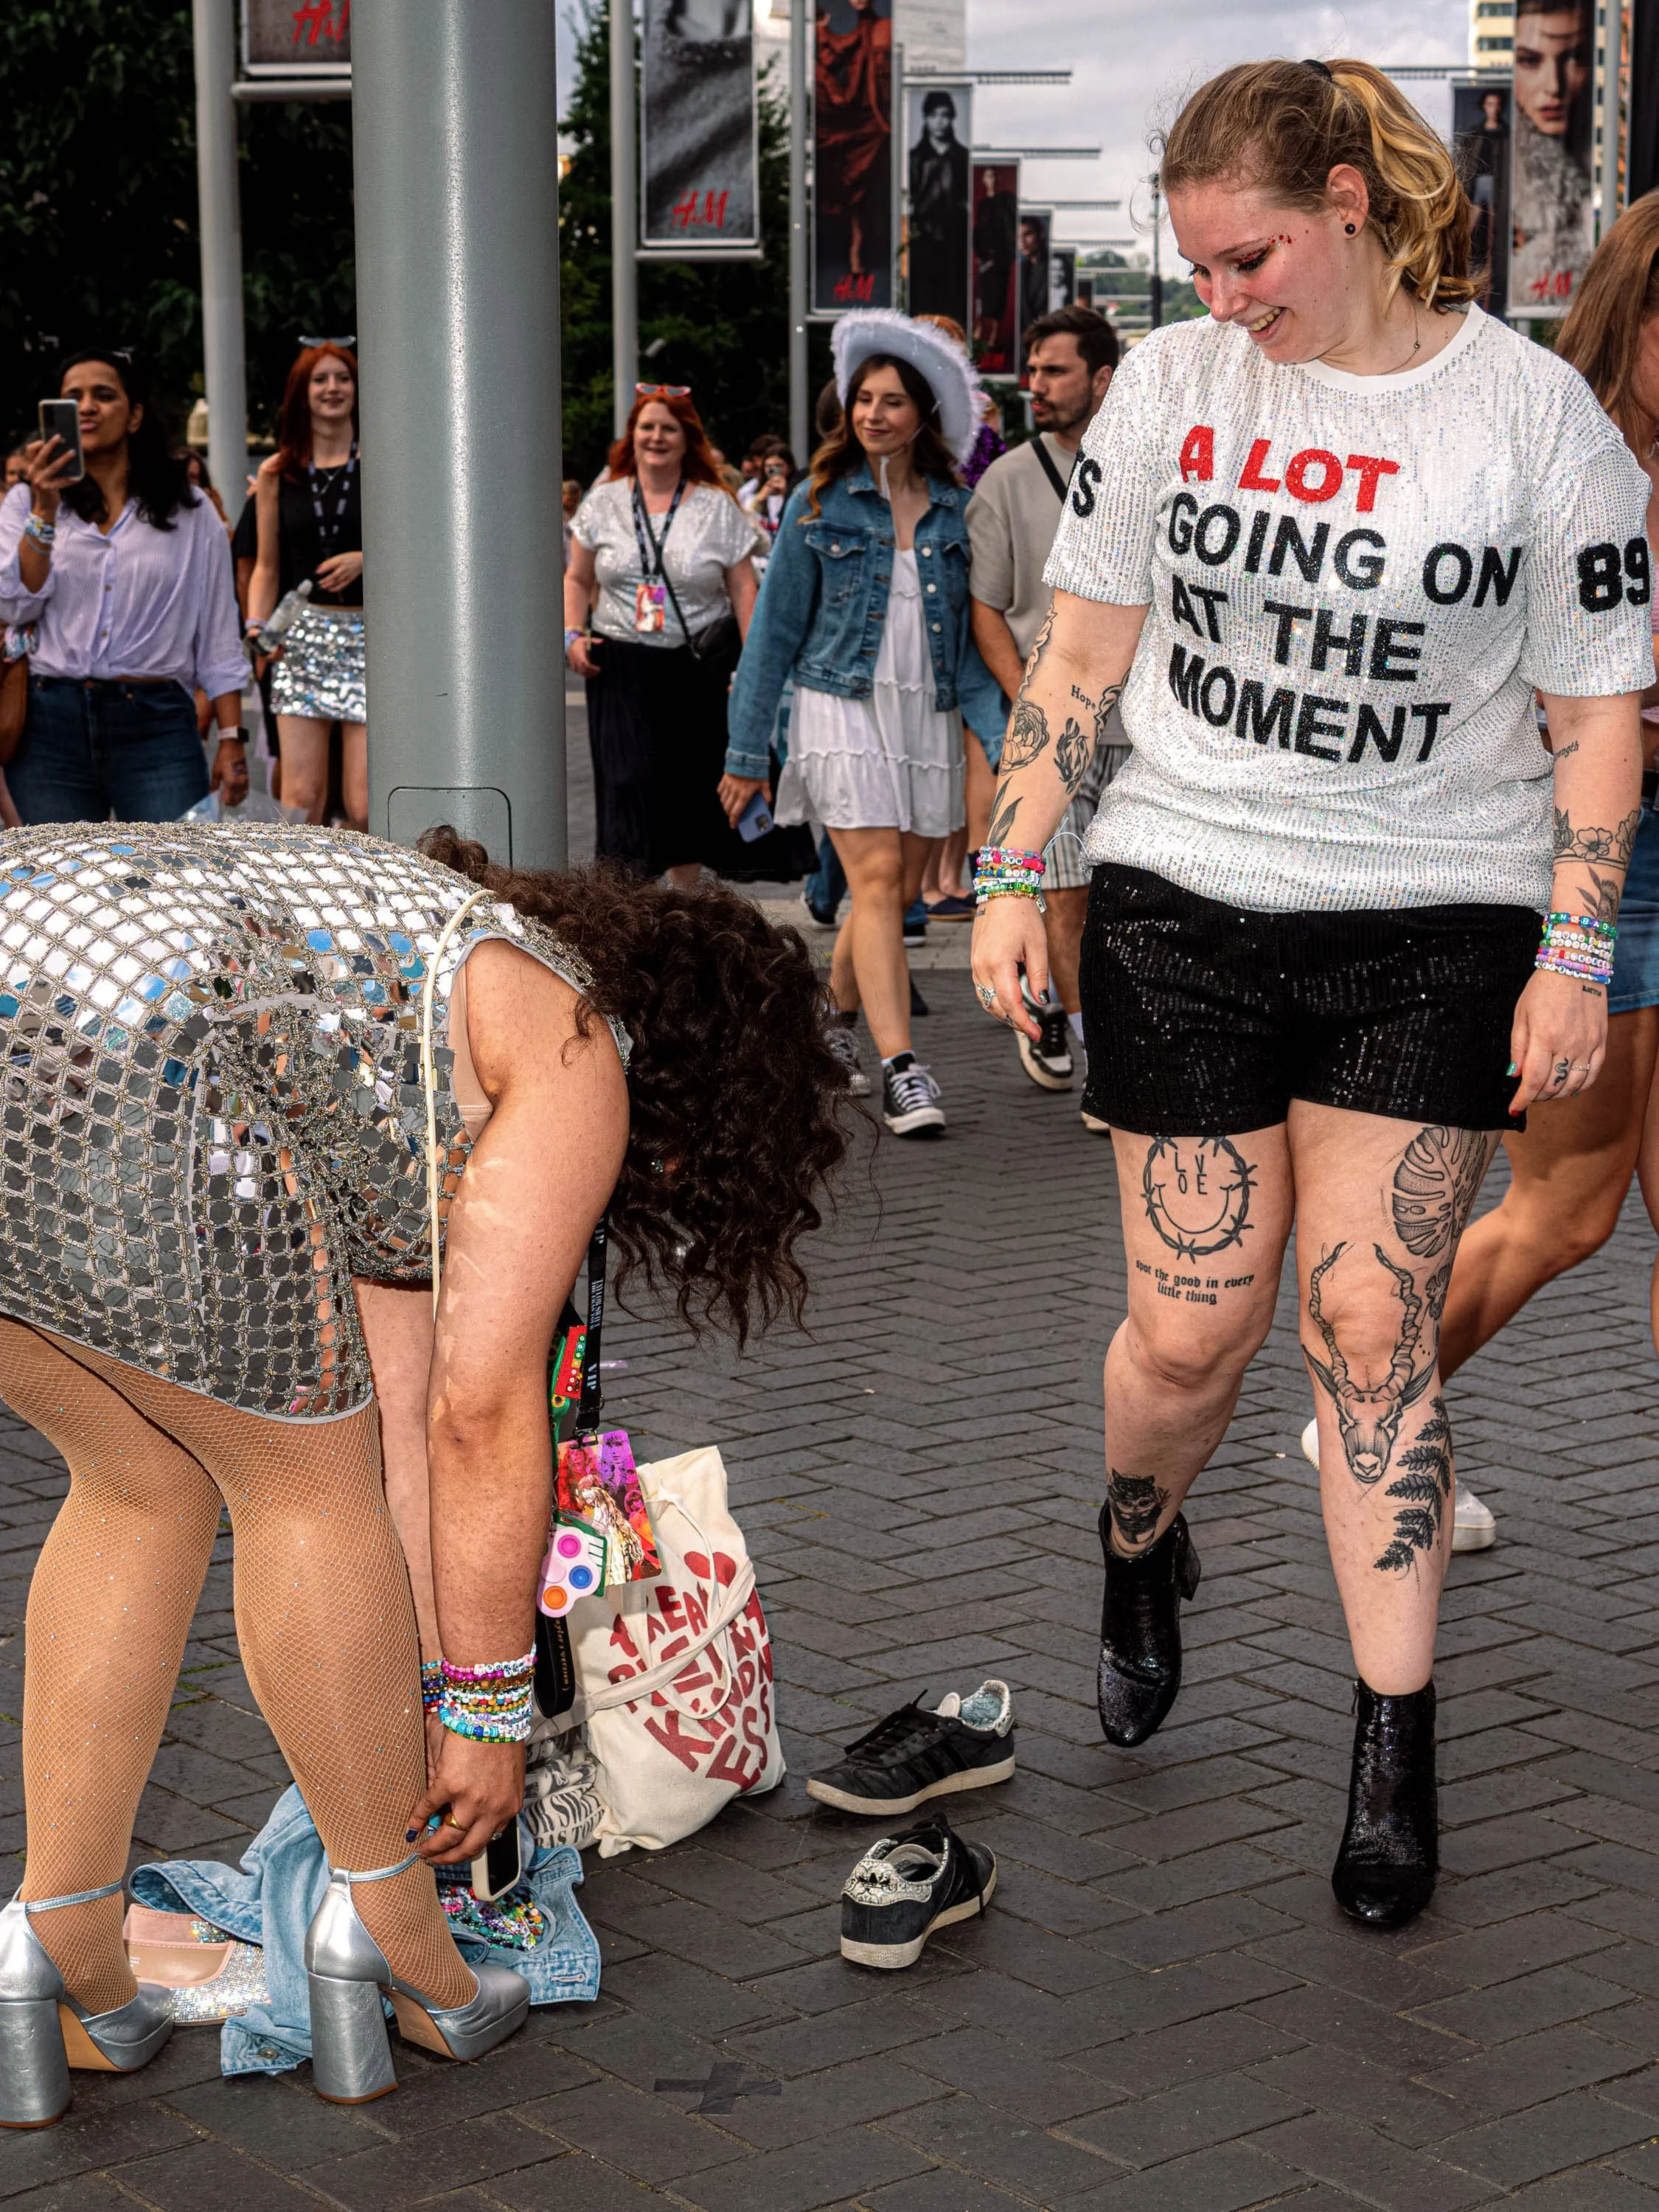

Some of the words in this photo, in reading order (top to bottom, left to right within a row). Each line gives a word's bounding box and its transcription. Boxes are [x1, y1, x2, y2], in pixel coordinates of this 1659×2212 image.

[1179, 425, 1214, 483] A
[1238, 438, 1401, 513] LOT
[1169, 492, 1387, 591] GOING
[1422, 542, 1523, 608] ON
[1577, 537, 1650, 613] 89
[1172, 574, 1228, 644] AT
[1263, 599, 1426, 682] THE
[1071, 684, 1096, 710] Hope
[1169, 642, 1451, 763] MOMENT
[1136, 1259, 1152, 1275] spot
[1155, 1268, 1169, 1281] the
[1174, 1275, 1201, 1288] good
[1206, 1276, 1218, 1289] in
[1224, 1274, 1254, 1289] every
[1158, 1281, 1182, 1299] little
[1186, 1290, 1217, 1305] thing
[587, 1363, 598, 1391] VIP
